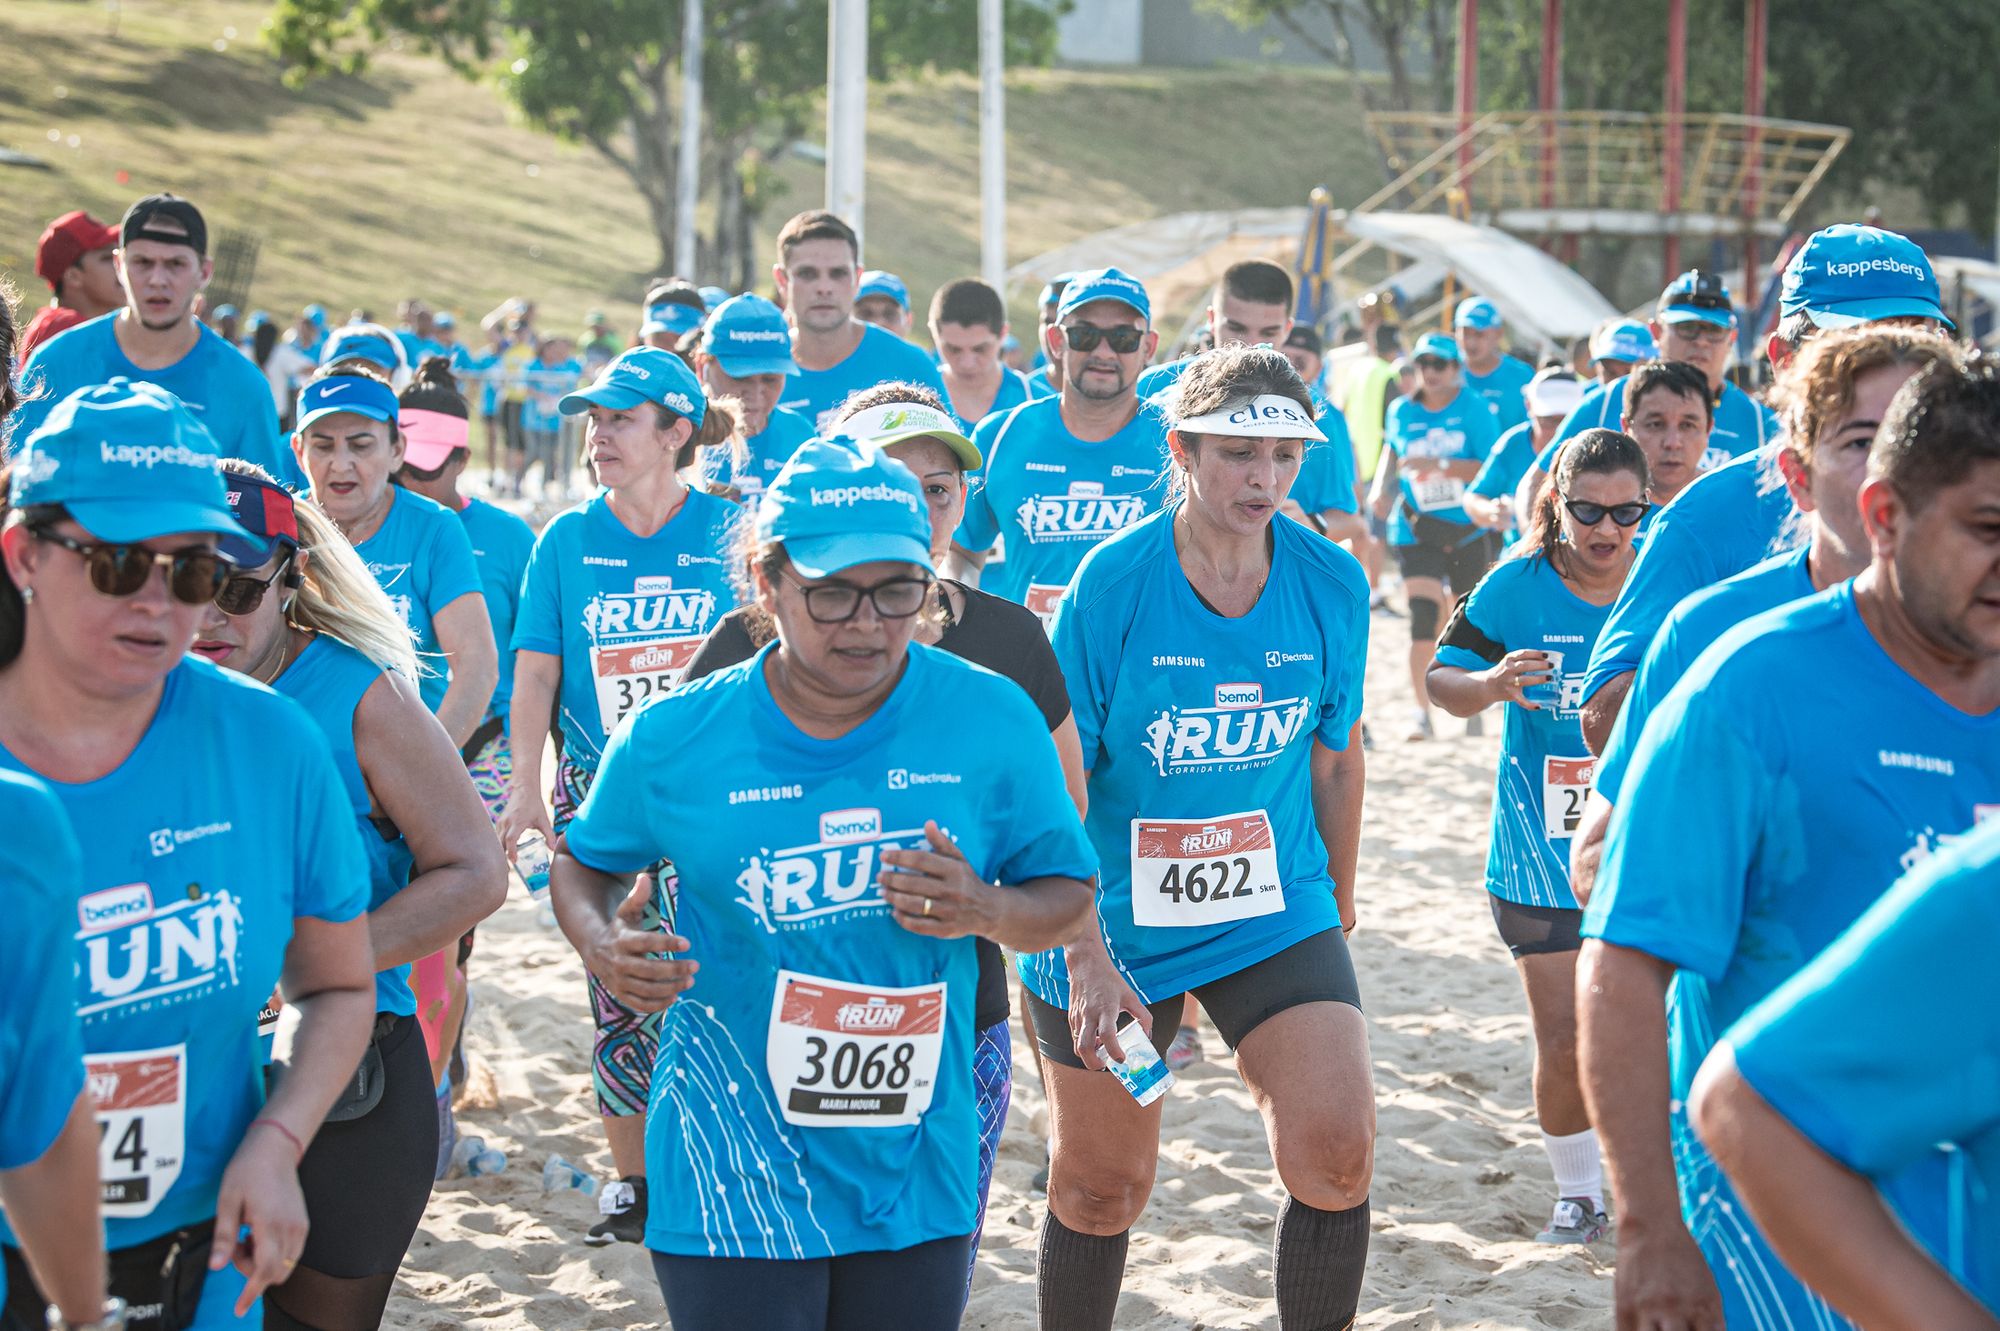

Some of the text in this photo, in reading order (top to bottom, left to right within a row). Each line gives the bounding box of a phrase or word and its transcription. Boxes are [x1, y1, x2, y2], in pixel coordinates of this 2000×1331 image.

[1826, 257, 1925, 281] kappesberg
[729, 329, 786, 344] kappesberg
[810, 482, 918, 513] kappesberg
[1035, 500, 1134, 532] RUN
[583, 556, 628, 567] SAMSUNG
[638, 581, 669, 591] bemol
[599, 595, 702, 634] RUN
[1543, 634, 1584, 643] SAMSUNG
[636, 650, 669, 667] RUN
[1152, 656, 1206, 668] SAMSUNG
[1282, 652, 1314, 663] Electrolux
[1218, 690, 1260, 703] bemol
[1167, 705, 1298, 760] RUN
[909, 771, 961, 785] Electrolux
[1169, 766, 1213, 775] CORRIDA
[1218, 765, 1223, 773] E
[729, 784, 803, 805] SAMSUNG
[824, 817, 877, 837] bemol
[1188, 831, 1227, 851] RUN
[1159, 857, 1254, 903] 4622
[1259, 884, 1277, 893] 5km
[84, 905, 217, 998] UN
[847, 1008, 897, 1026] RUN
[796, 1036, 915, 1090] 3068
[819, 1098, 881, 1111] MARIA MOURA
